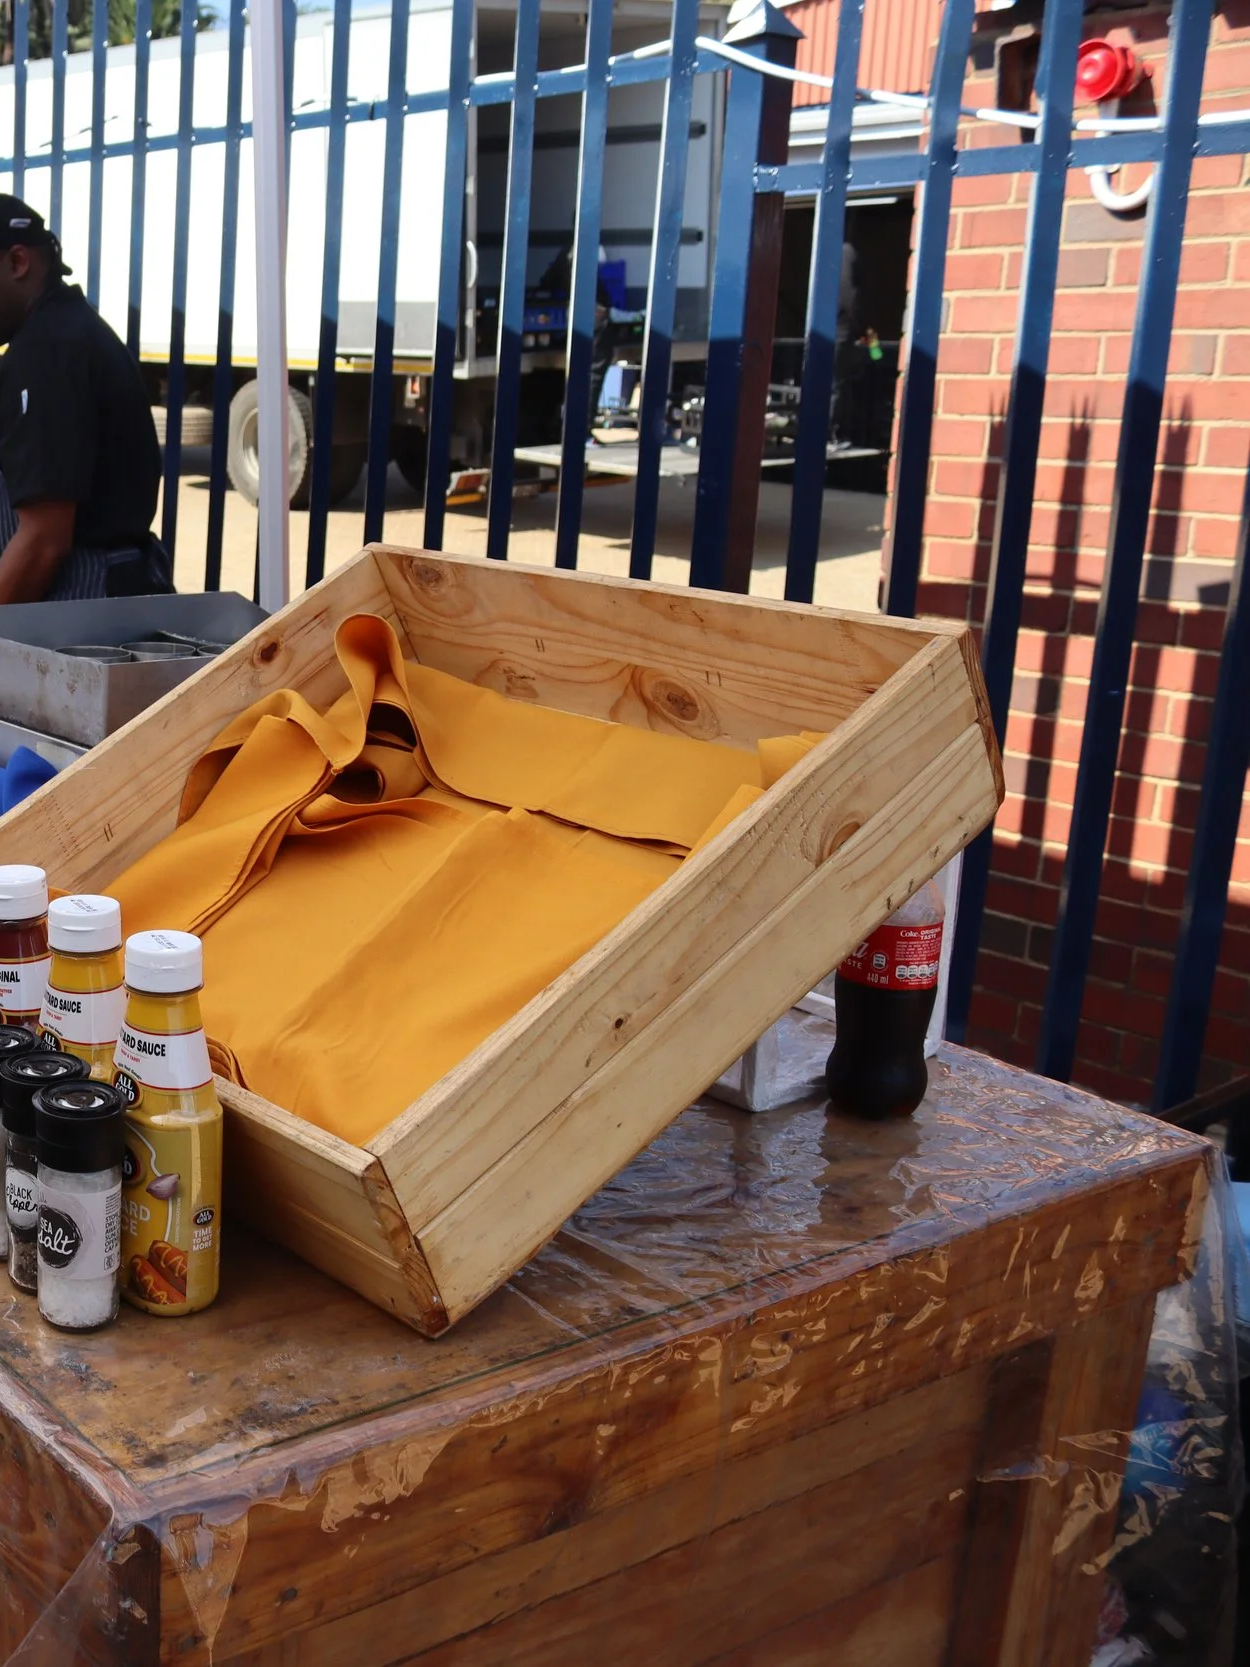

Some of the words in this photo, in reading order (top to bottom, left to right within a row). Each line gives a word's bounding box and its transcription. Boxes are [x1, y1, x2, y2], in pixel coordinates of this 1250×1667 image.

[900, 929, 918, 938] Coke
[58, 998, 82, 1013] SAUCE
[44, 1033, 56, 1047] ALL
[136, 1040, 166, 1057] SAUCE
[118, 1073, 133, 1089] ALL
[9, 1183, 33, 1201] BLACK
[200, 1210, 210, 1218] ALL
[40, 1216, 53, 1235] SEA
[194, 1226, 212, 1238] TIME
[38, 1227, 76, 1255] salt
[192, 1240, 212, 1251] MORE
